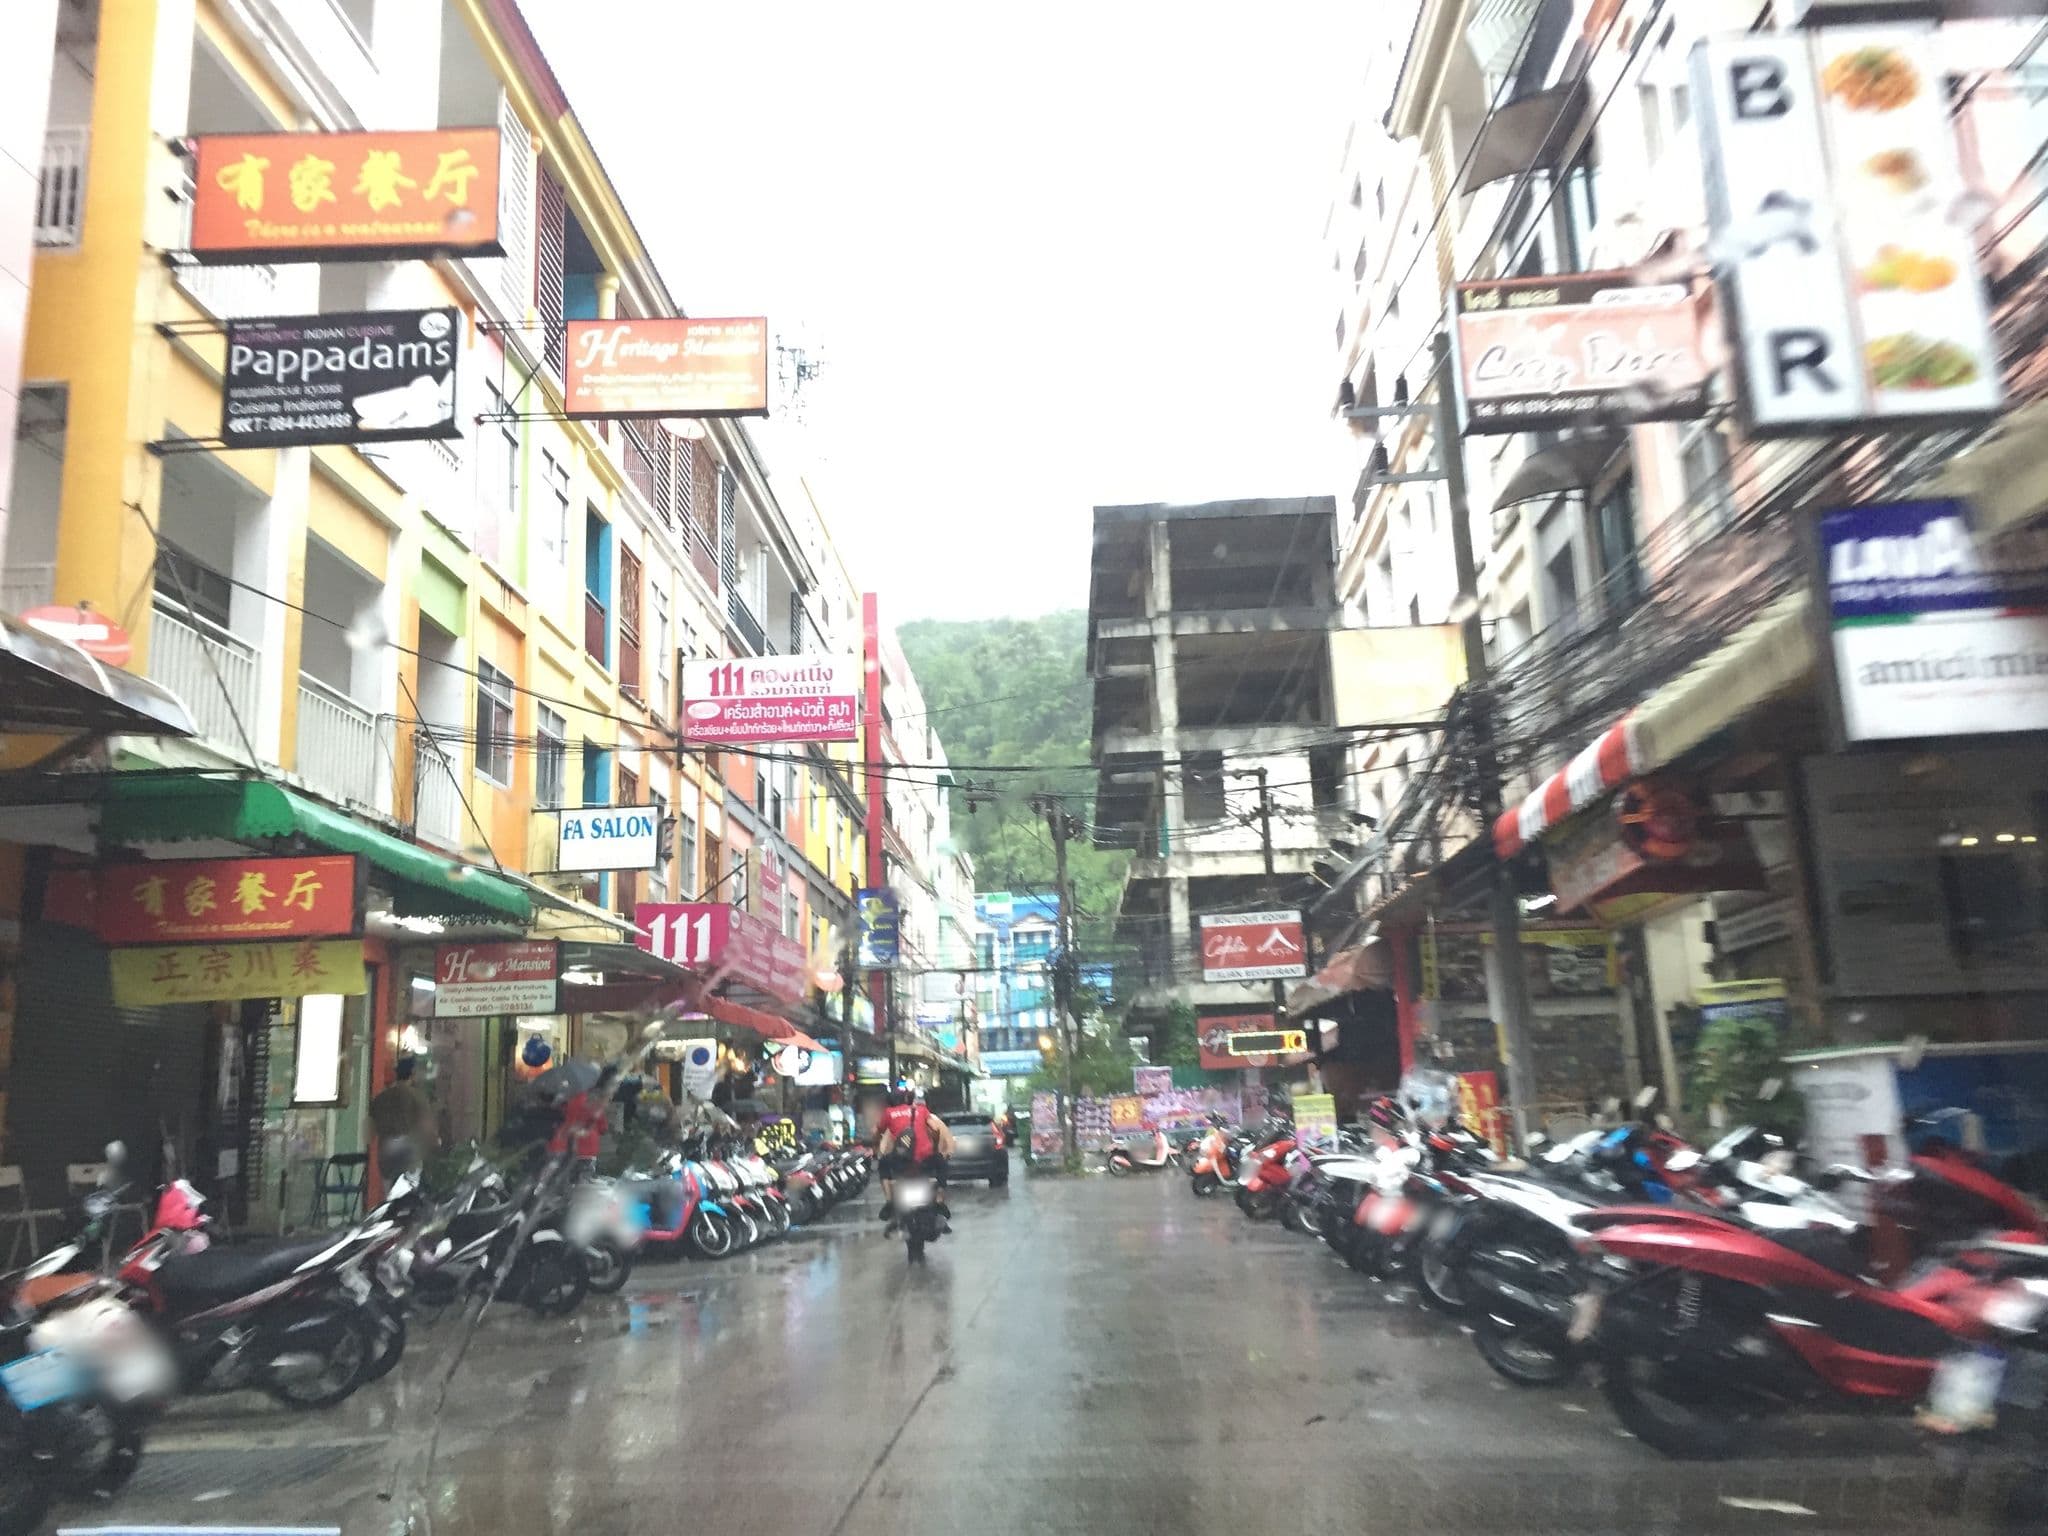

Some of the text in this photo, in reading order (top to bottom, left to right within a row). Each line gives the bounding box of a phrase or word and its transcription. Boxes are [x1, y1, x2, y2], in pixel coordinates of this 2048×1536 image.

[303, 327, 345, 340] INDIAN
[347, 324, 395, 338] CUISINE
[231, 336, 451, 383] Pappadams
[229, 398, 344, 415] Cuisine Indienne
[709, 662, 746, 697] 111
[563, 815, 653, 840] FA SALON
[648, 911, 711, 964] 111
[151, 944, 329, 983] 正宗川菜
[505, 957, 551, 972] Mansion
